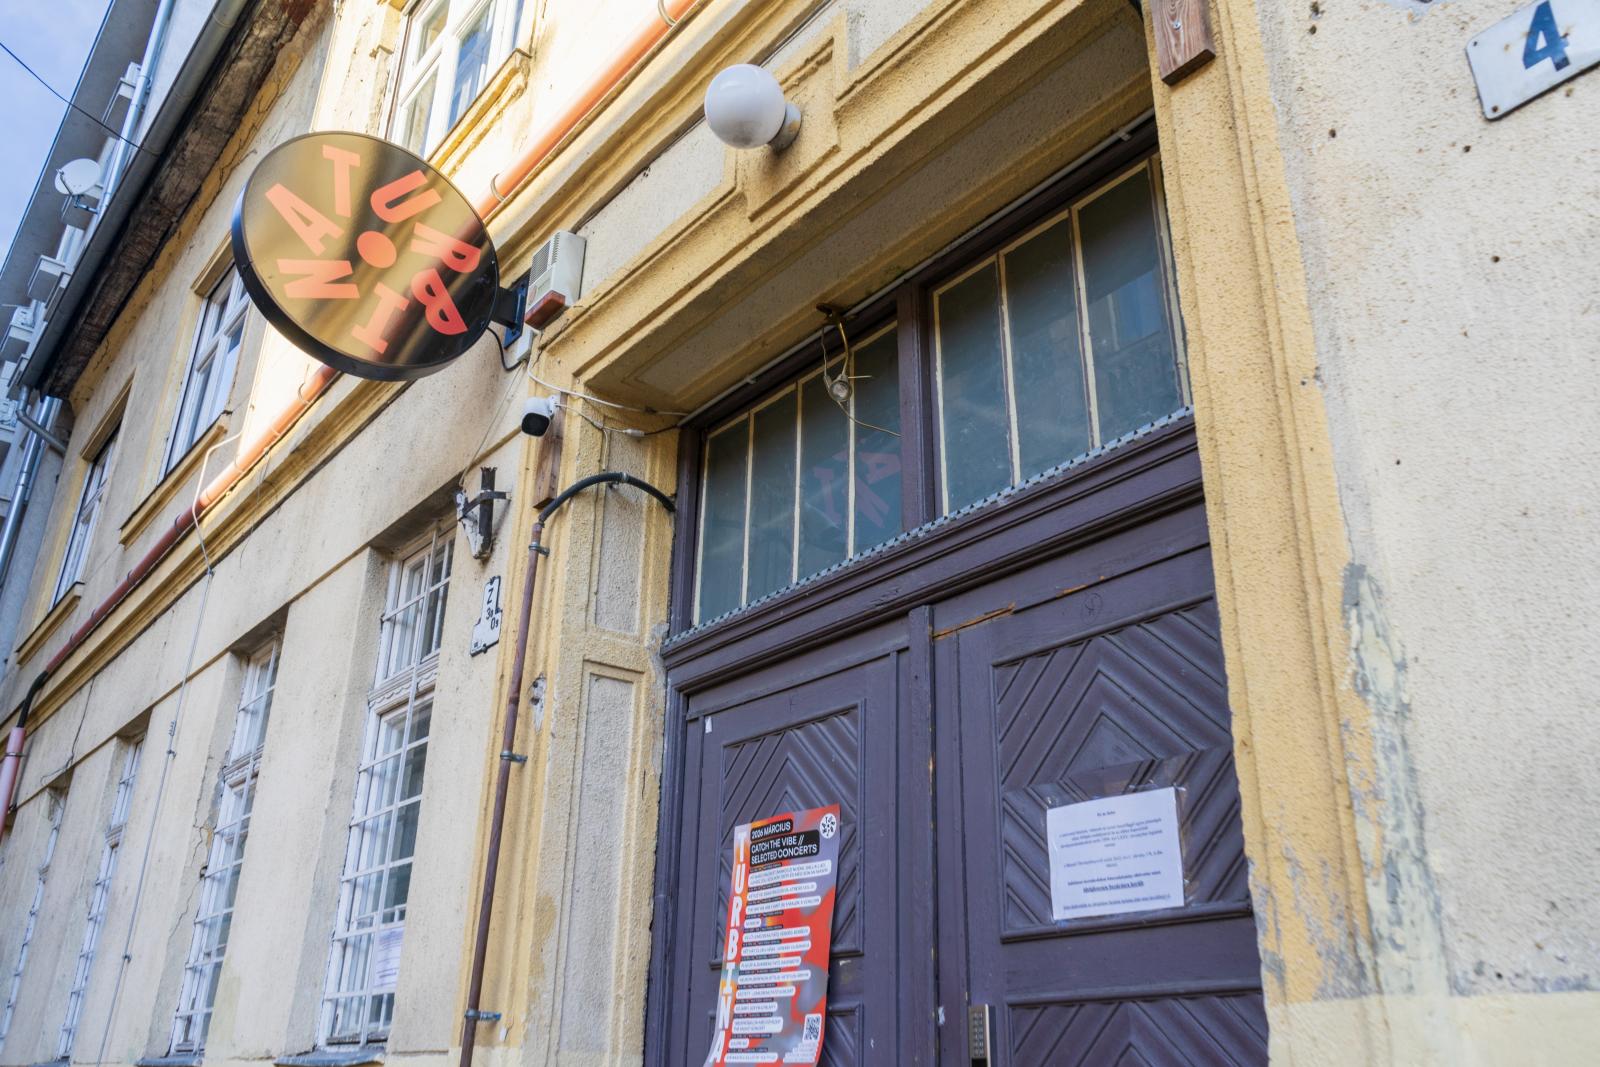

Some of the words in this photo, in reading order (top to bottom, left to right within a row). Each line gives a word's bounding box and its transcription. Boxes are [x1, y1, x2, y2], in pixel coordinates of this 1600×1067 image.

[1522, 0, 1570, 72] 4
[751, 842, 769, 853] CATCH
[770, 839, 780, 849] THE
[780, 835, 797, 847] VIBE
[751, 850, 777, 865] SELECTED
[778, 843, 817, 859] CONCERTS
[709, 831, 747, 1063] TURBINA
